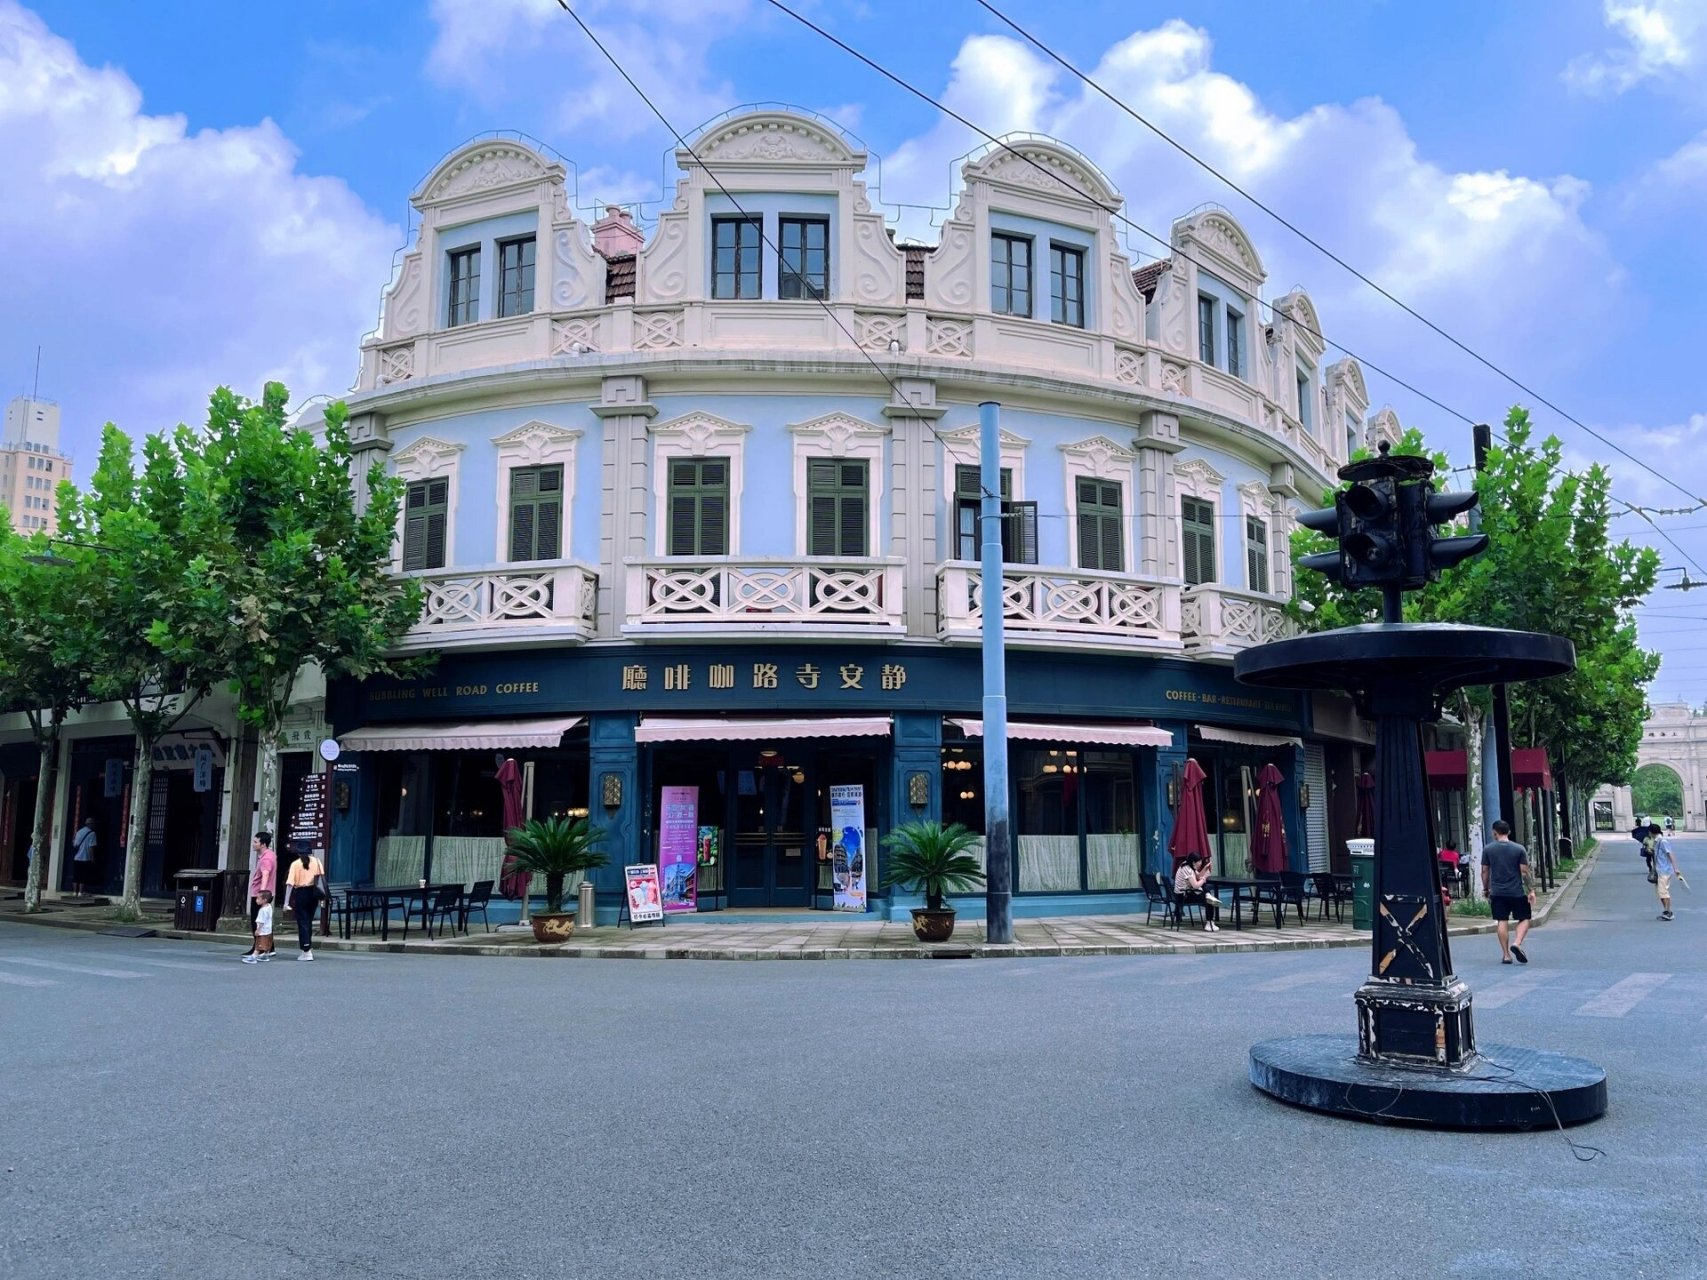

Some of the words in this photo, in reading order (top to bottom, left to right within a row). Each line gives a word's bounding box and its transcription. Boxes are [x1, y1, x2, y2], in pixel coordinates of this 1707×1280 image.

[369, 688, 416, 701] BUBBLING
[422, 687, 448, 698] WELL
[456, 685, 487, 696] ROAD
[495, 682, 539, 694] COFFEE
[1165, 689, 1197, 702] COFFEE
[1201, 693, 1217, 703] BAR
